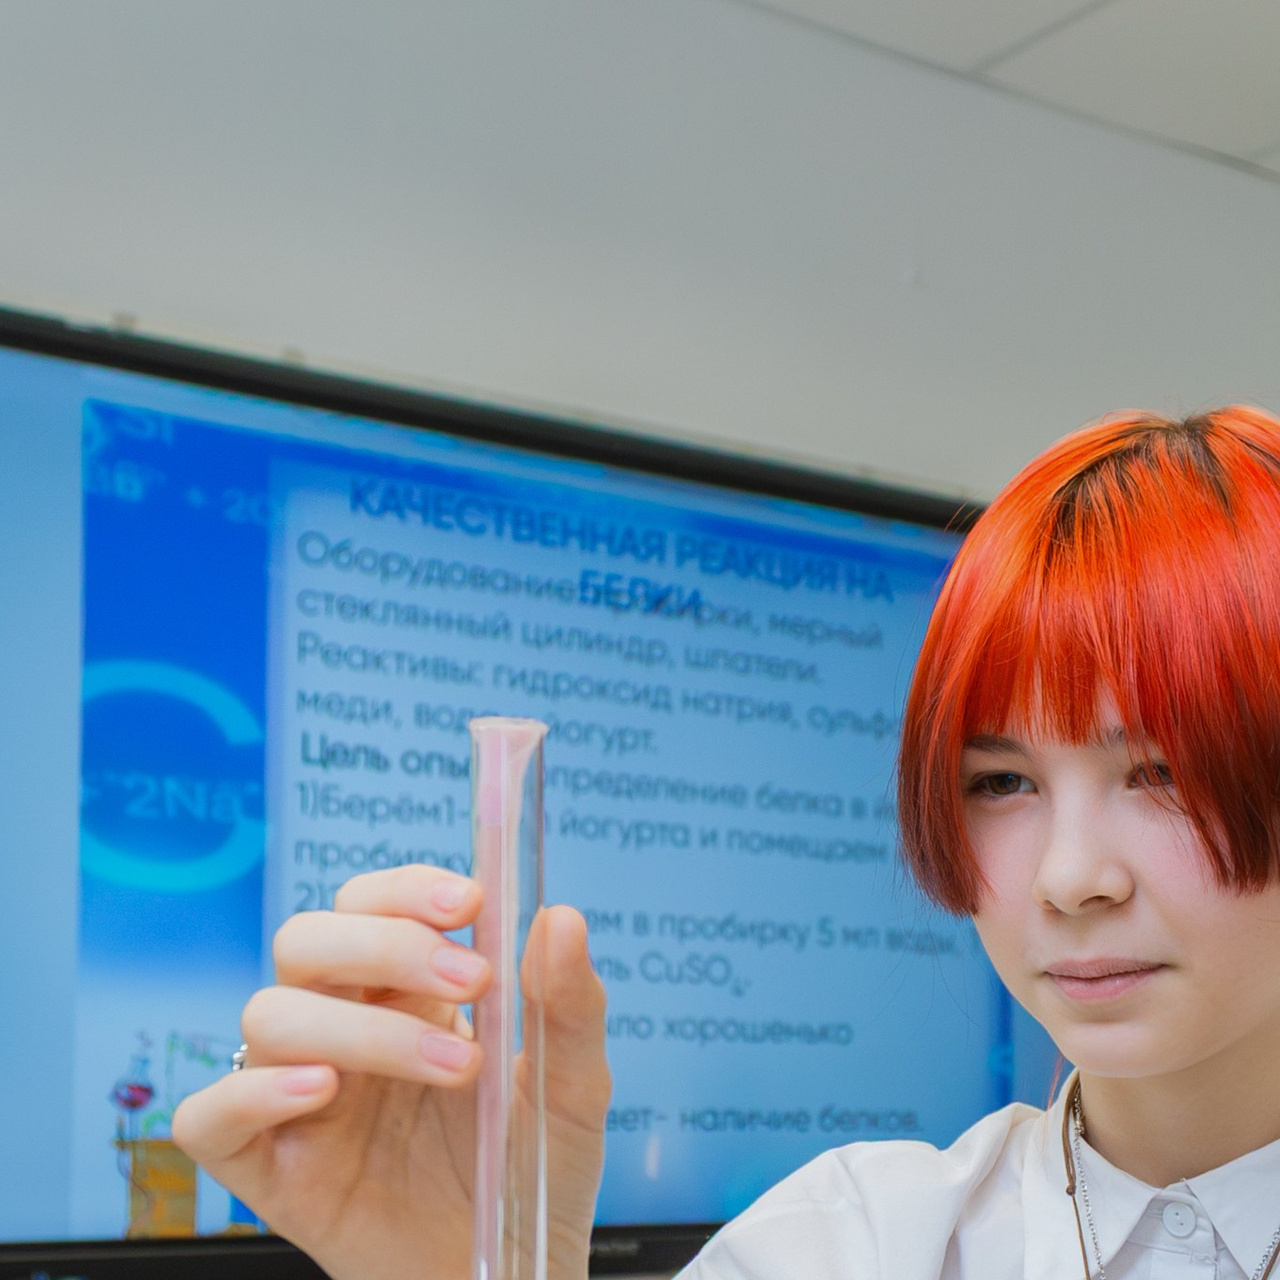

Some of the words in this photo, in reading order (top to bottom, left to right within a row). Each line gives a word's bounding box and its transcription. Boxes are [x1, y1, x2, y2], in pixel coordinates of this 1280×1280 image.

[350, 477, 666, 563] КАЧЕСТВЕННАЯ
[675, 531, 838, 592] РЕАКЦИЯ
[845, 560, 894, 602] НА
[296, 587, 512, 642] стеклянный
[492, 661, 672, 715] гидроксид
[300, 730, 390, 776] Цель
[399, 749, 471, 780] опы
[546, 764, 749, 810] пределение
[559, 806, 690, 850] йогурта
[659, 910, 808, 955] пробирку
[816, 914, 834, 948] 5
[662, 1014, 854, 1047] хорошенько
[606, 1107, 668, 1133] вет-
